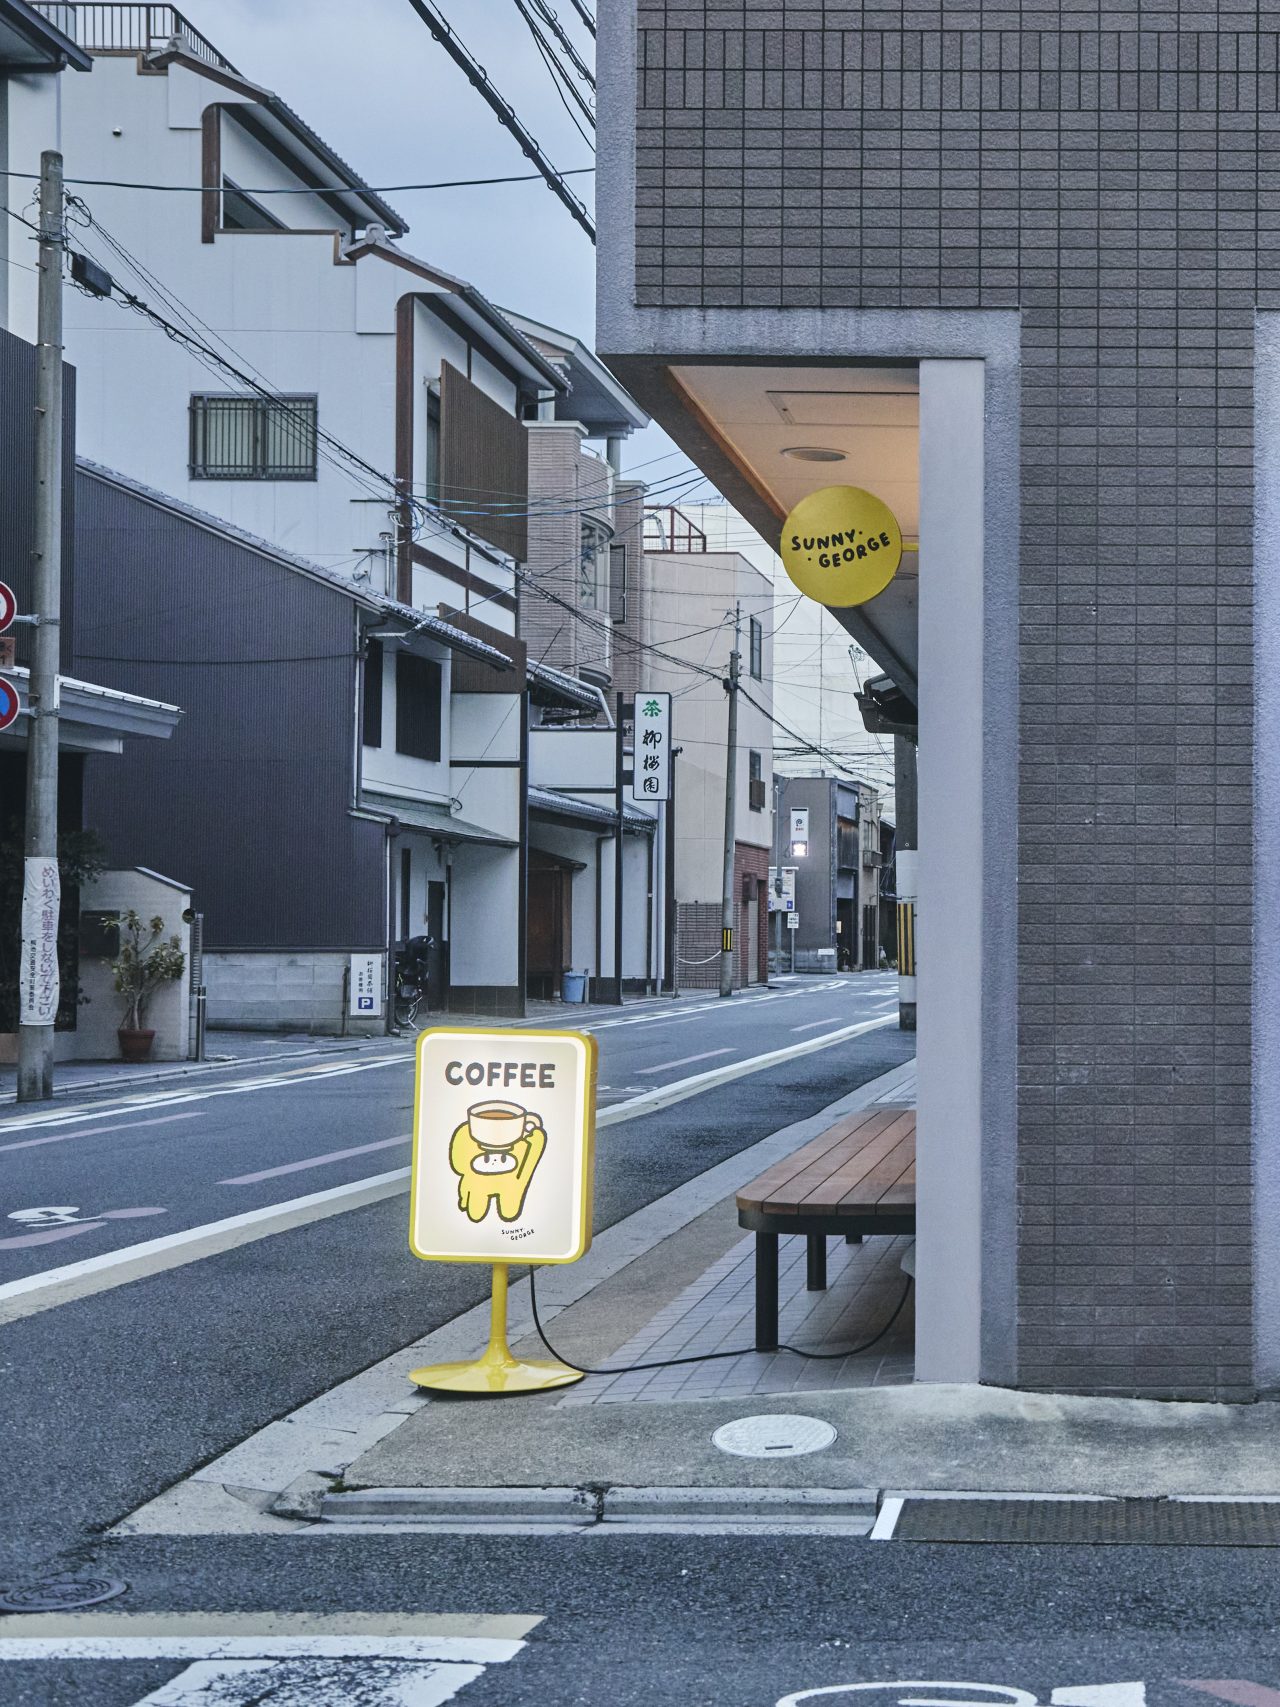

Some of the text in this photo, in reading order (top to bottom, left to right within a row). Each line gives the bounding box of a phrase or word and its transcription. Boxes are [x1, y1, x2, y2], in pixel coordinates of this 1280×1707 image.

[791, 528, 856, 551] SUNNY
[818, 532, 891, 568] GEORGE
[642, 699, 662, 793] 茶 柳桜園
[38, 866, 55, 1016] めいわく駐車をしないで下さい
[361, 998, 371, 1008] P
[445, 1061, 556, 1089] COFFEE
[510, 1228, 535, 1241] GEORGE
